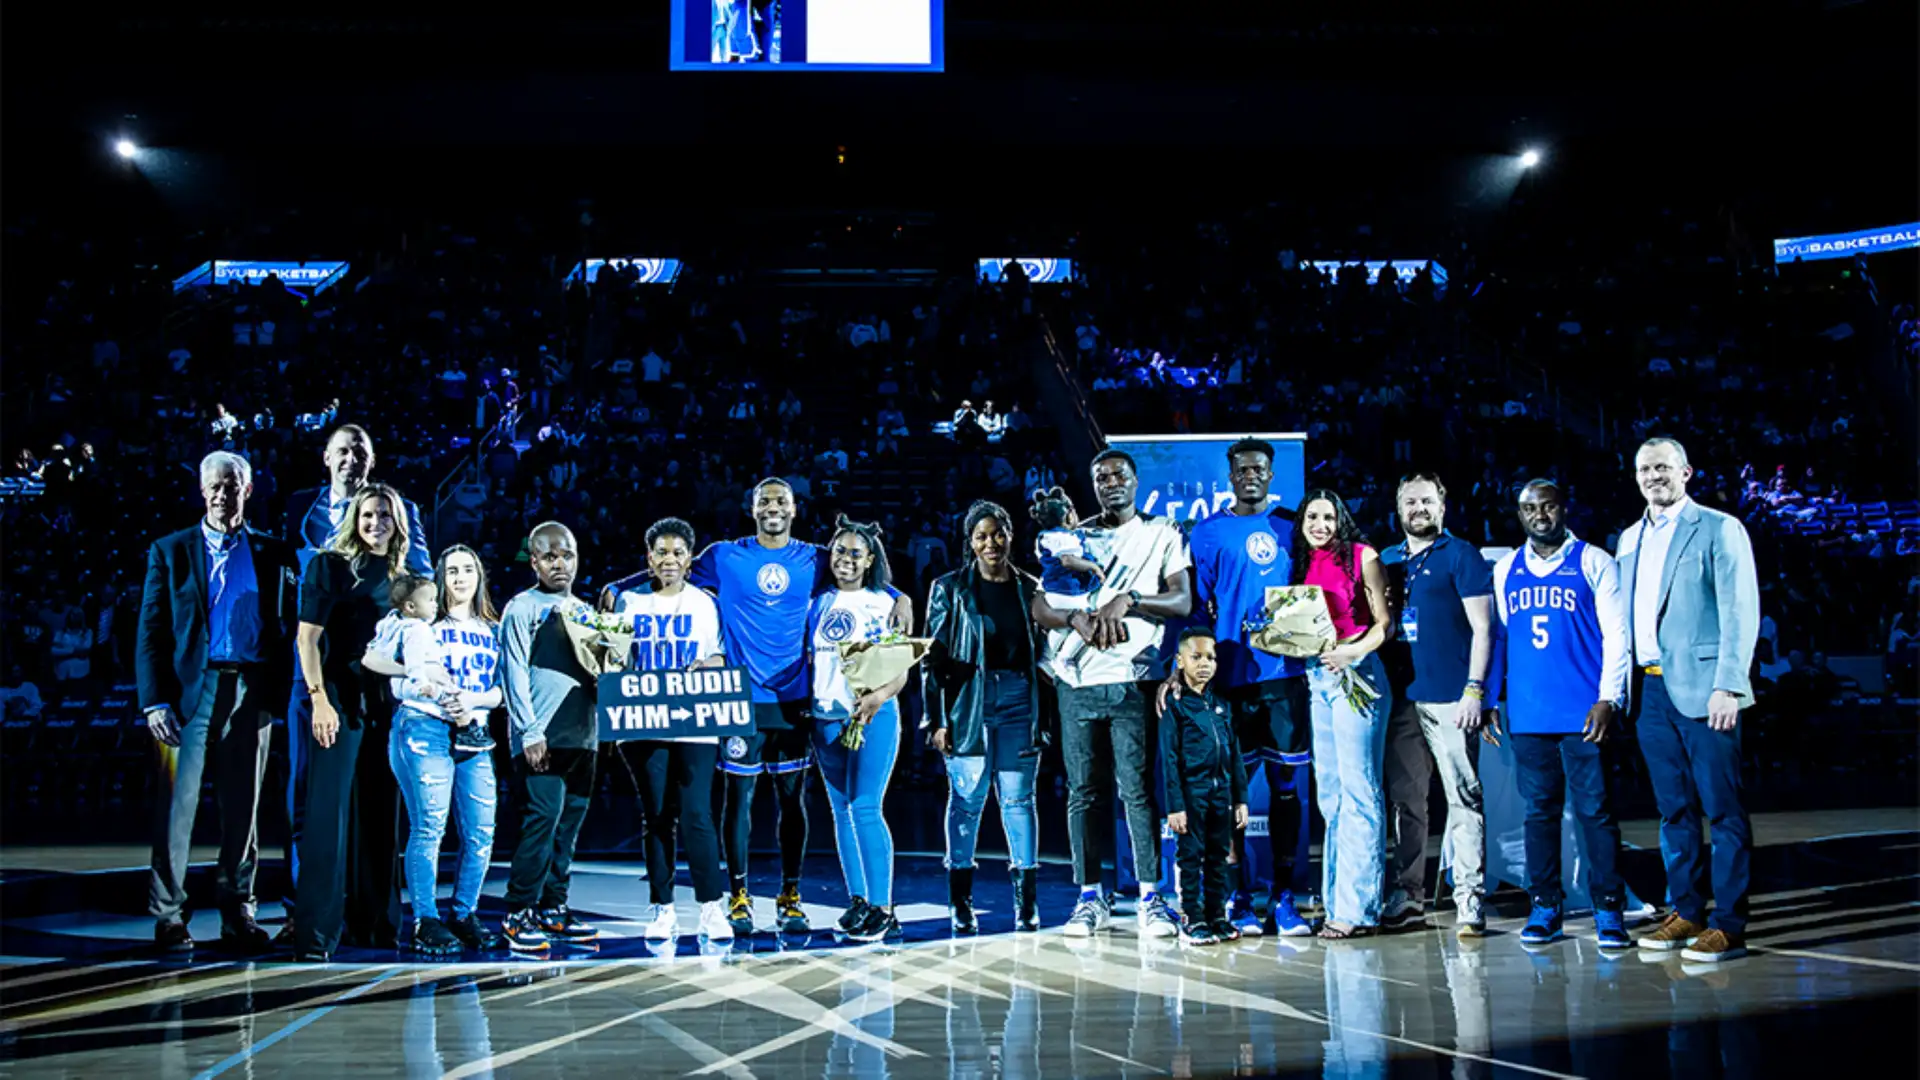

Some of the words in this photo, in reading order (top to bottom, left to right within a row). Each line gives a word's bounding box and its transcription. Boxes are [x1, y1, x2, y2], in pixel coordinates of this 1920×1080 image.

[1508, 586, 1577, 615] COUGS
[633, 614, 692, 638] BYU
[1531, 615, 1549, 650] 5
[620, 673, 660, 698] GO
[665, 670, 743, 696] RUDI!
[606, 704, 670, 730] YHM
[694, 700, 751, 727] PVU
